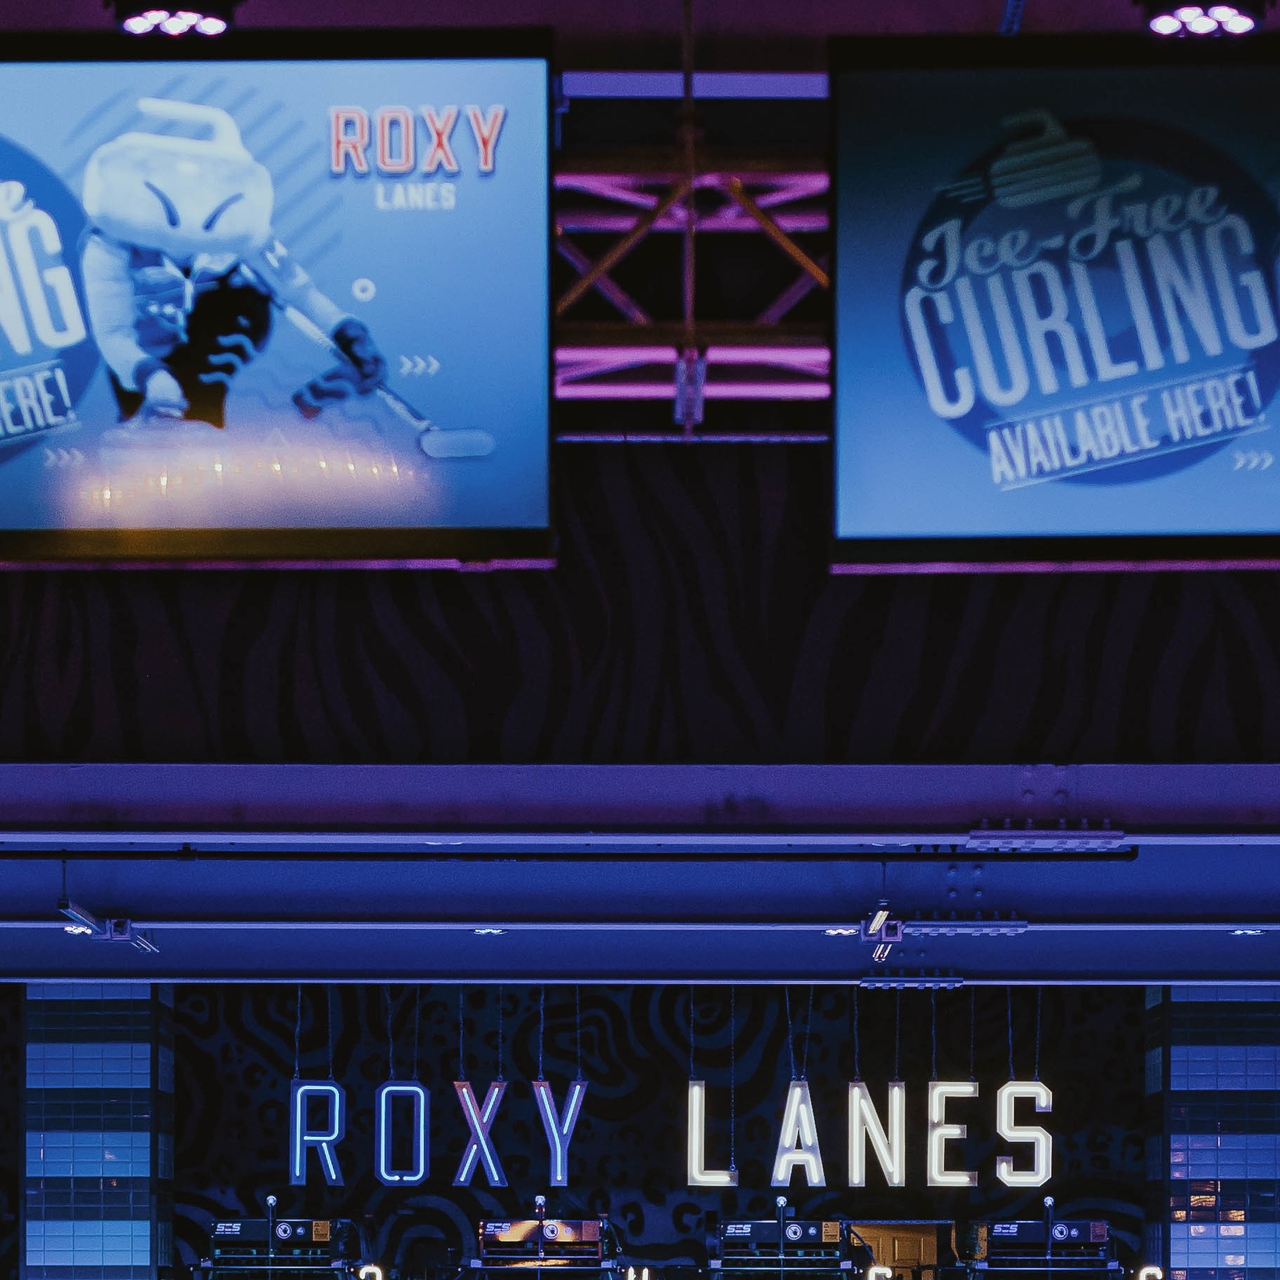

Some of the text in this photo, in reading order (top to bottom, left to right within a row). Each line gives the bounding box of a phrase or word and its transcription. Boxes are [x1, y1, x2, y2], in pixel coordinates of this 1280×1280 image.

[328, 104, 507, 175] ROXY
[375, 182, 457, 210] LANES
[904, 213, 1279, 419] CURLING
[986, 370, 1267, 485] AVAILABLE HERE!
[289, 1080, 1053, 1187] ROXY LANES
